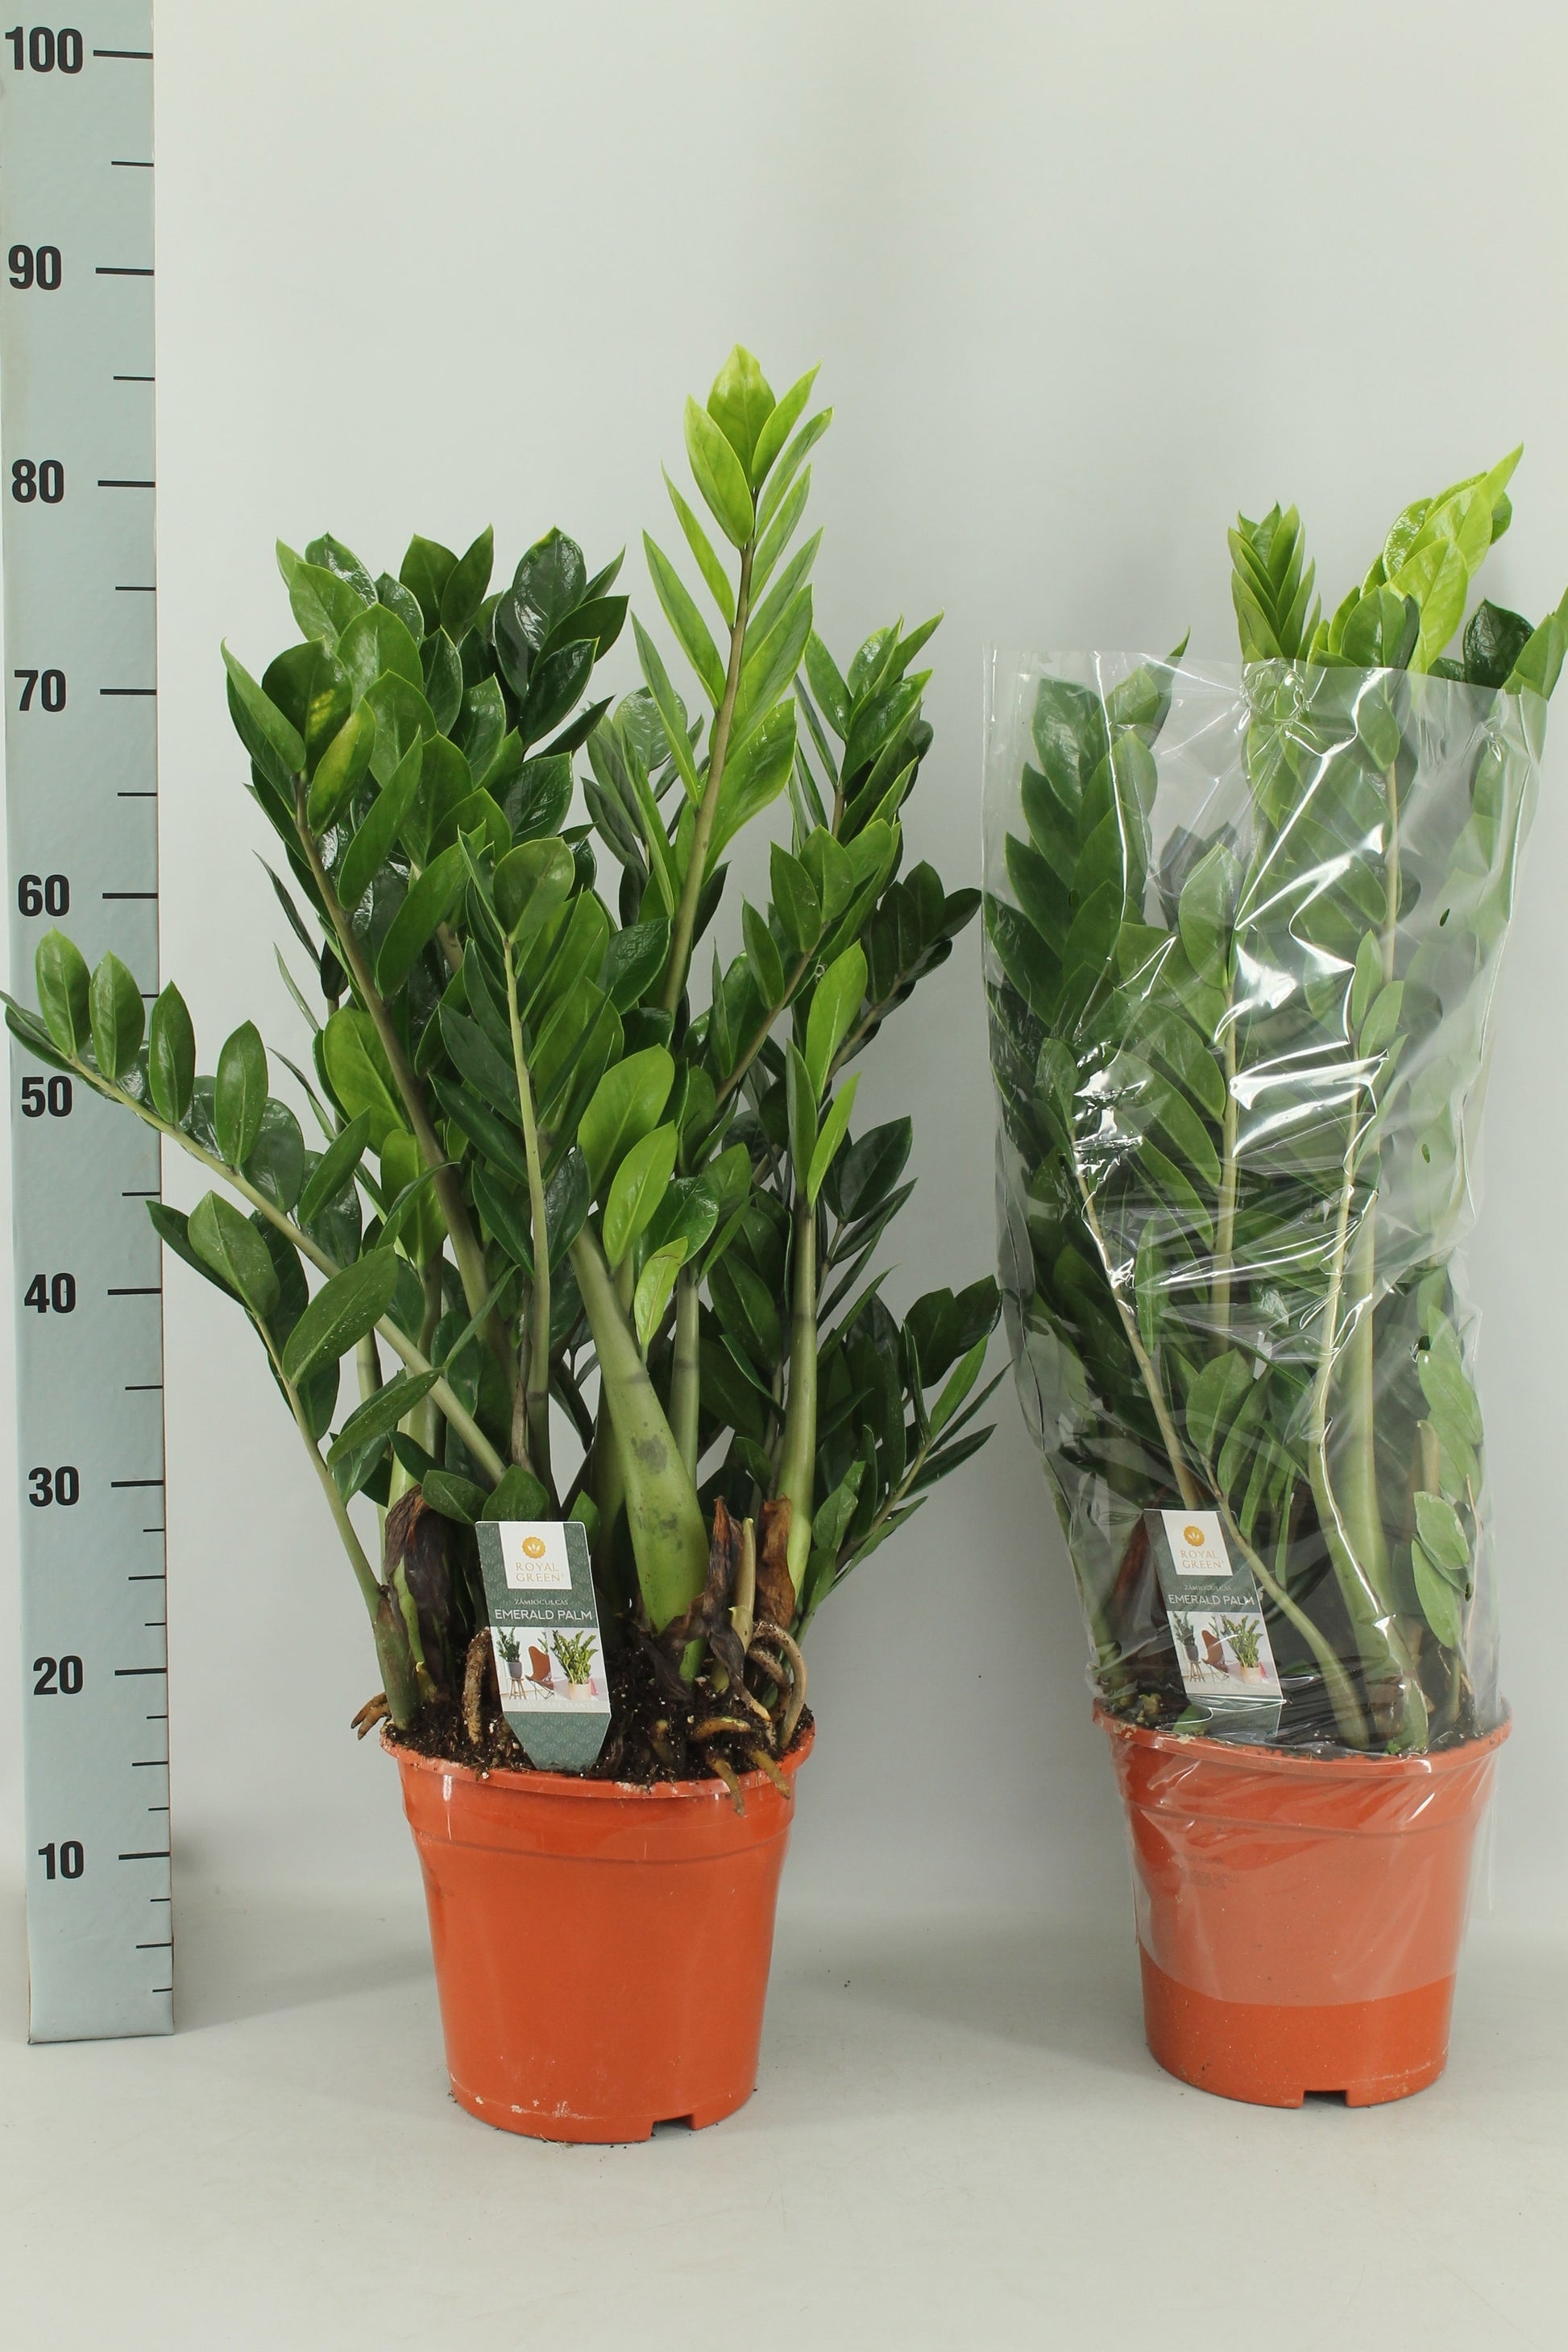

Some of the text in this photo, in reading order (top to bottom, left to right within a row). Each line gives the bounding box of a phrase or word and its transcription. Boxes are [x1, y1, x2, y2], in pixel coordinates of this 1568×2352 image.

[5, 26, 83, 74] 100
[8, 244, 62, 291] 90
[11, 458, 64, 504] 80
[14, 669, 66, 712] 70
[18, 874, 70, 917] 60
[21, 1075, 73, 1118] 50
[23, 1272, 76, 1314] 40
[28, 1466, 80, 1508] 30
[515, 1562, 559, 1572] ROYAL
[1180, 1549, 1219, 1559] ROYAL
[1181, 1559, 1222, 1570] GREEN
[515, 1572, 561, 1583] GREEN
[494, 1608, 593, 1620] EMERALD PALM
[514, 1598, 569, 1606] ZAMIOCULCAS
[1168, 1594, 1255, 1606] EMERALD PALM
[33, 1655, 84, 1696] 20
[38, 1840, 85, 1880] 10
